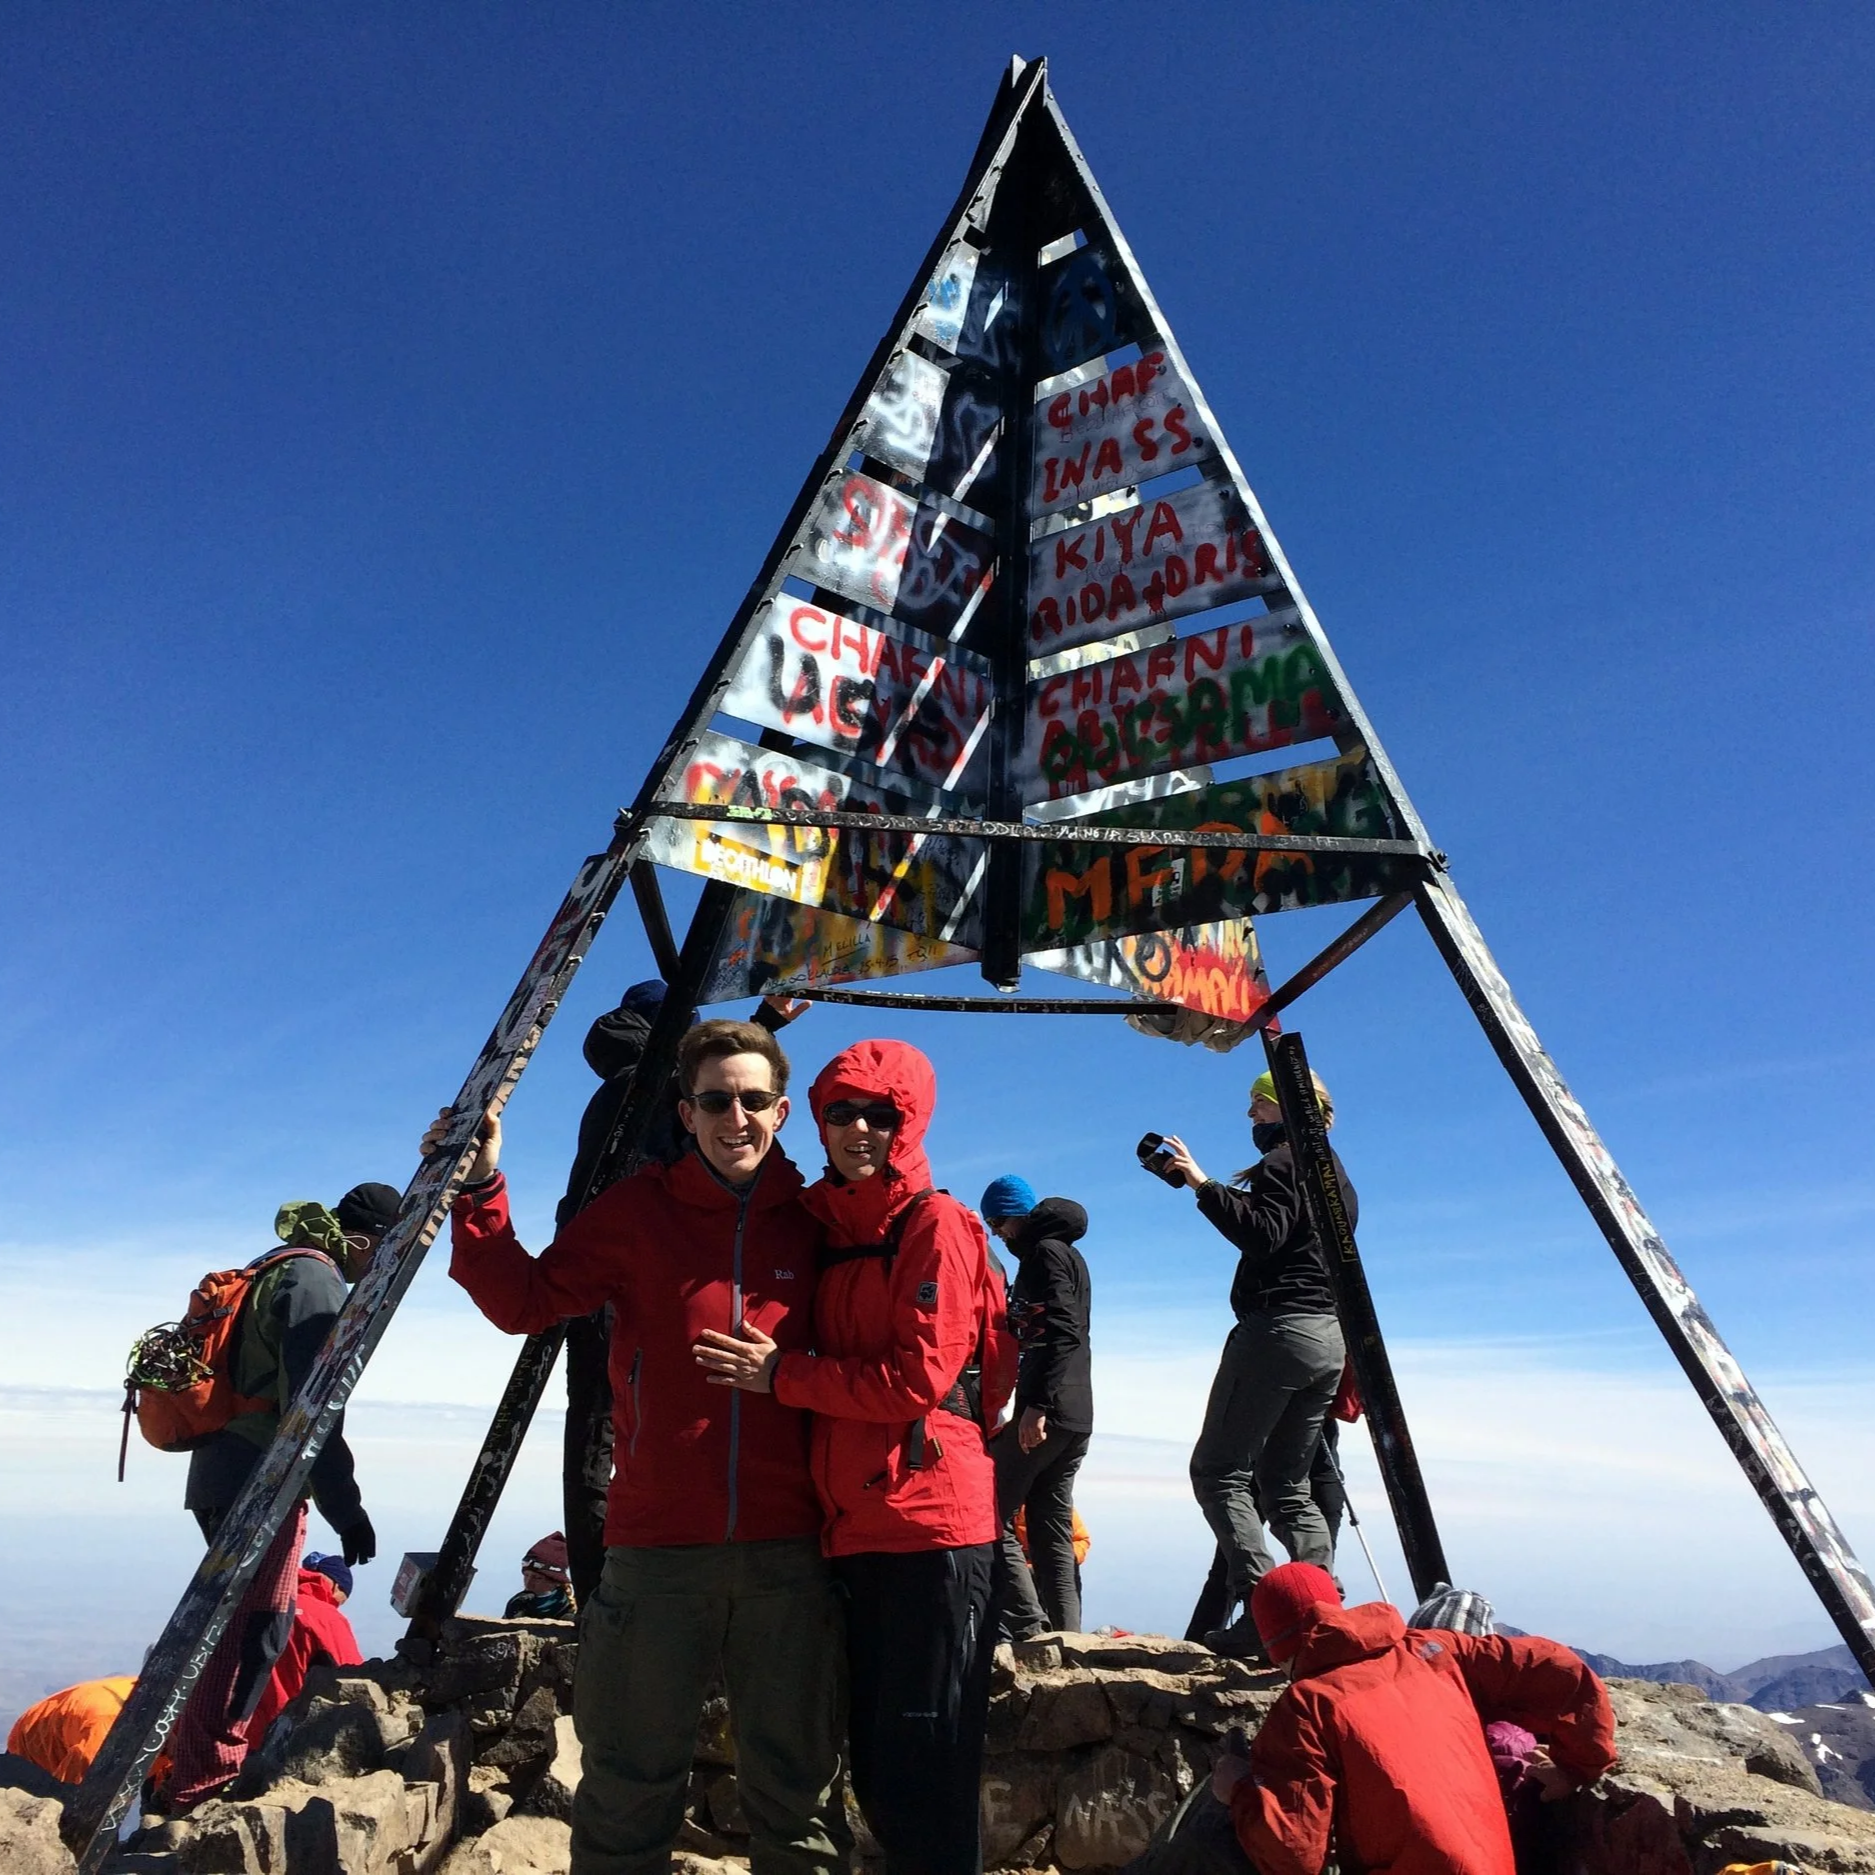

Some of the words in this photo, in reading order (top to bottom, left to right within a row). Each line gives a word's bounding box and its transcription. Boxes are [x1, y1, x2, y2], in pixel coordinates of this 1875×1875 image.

[1043, 407, 1193, 503] INASS
[1056, 502, 1183, 579] KIYA
[775, 1269, 795, 1280] Rab
